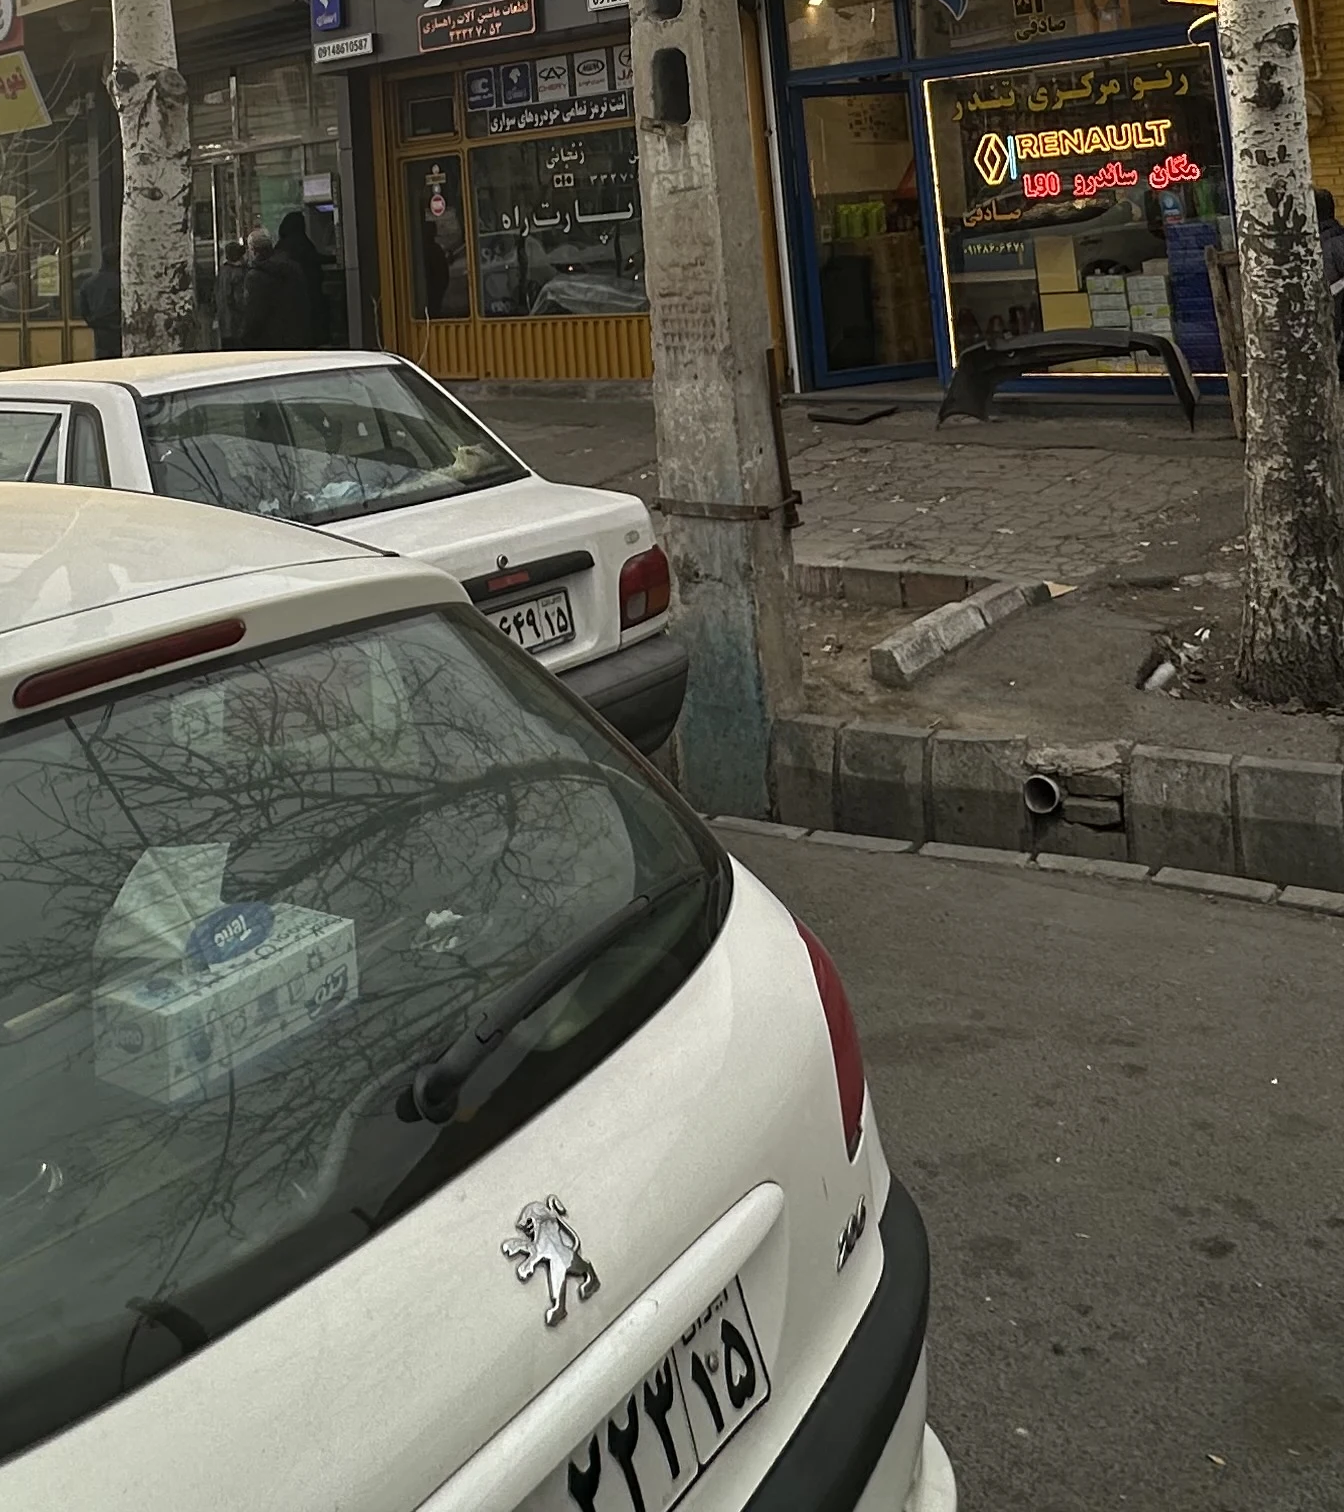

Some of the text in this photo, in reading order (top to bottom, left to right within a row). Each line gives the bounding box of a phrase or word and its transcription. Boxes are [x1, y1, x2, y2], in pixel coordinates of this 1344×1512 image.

[1014, 118, 1173, 160] RENAULT
[502, 199, 635, 245] پارت راه
[543, 603, 568, 636] ۱۵
[690, 1317, 758, 1435] ۱۵
